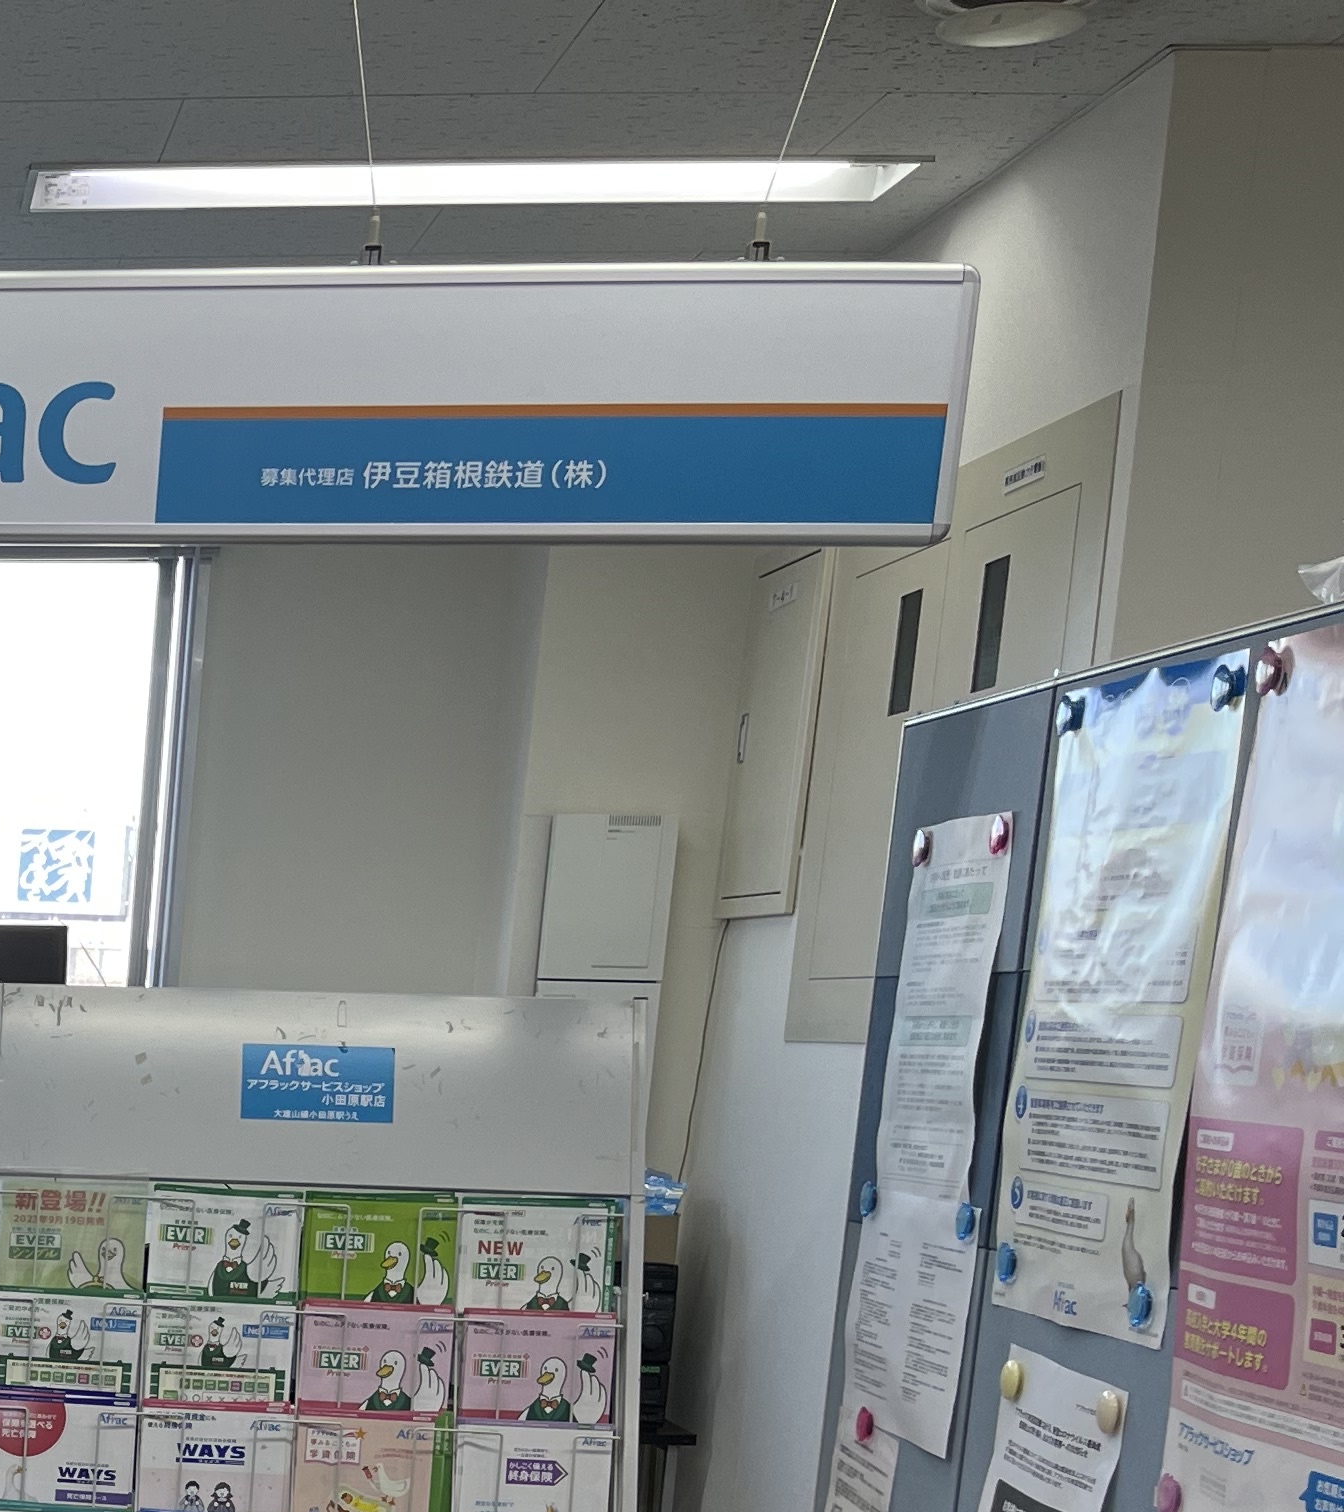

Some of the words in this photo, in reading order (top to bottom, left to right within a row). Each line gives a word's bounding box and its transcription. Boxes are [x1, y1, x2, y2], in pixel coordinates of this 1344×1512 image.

[261, 468, 354, 487] 募集代理店
[260, 1050, 339, 1077] Aflac
[247, 1079, 385, 1093] アフラックサービスショップ
[321, 1094, 386, 1108] 小田原駅店
[15, 1188, 106, 1213] 新登場!!
[16, 1235, 55, 1245] EVER
[166, 1227, 205, 1243] EVER
[326, 1235, 364, 1249] EVER
[13, 1248, 58, 1258] シンプル
[478, 1240, 523, 1256] NEW
[479, 1264, 517, 1278] EVER
[320, 1352, 358, 1368] EVER
[480, 1360, 519, 1376] EVER
[396, 1429, 428, 1440] Aflac
[177, 1442, 245, 1459] WAYS
[509, 1462, 553, 1470] かしこく備える
[58, 1466, 116, 1481] WAYS
[507, 1470, 553, 1483] 終身保険
